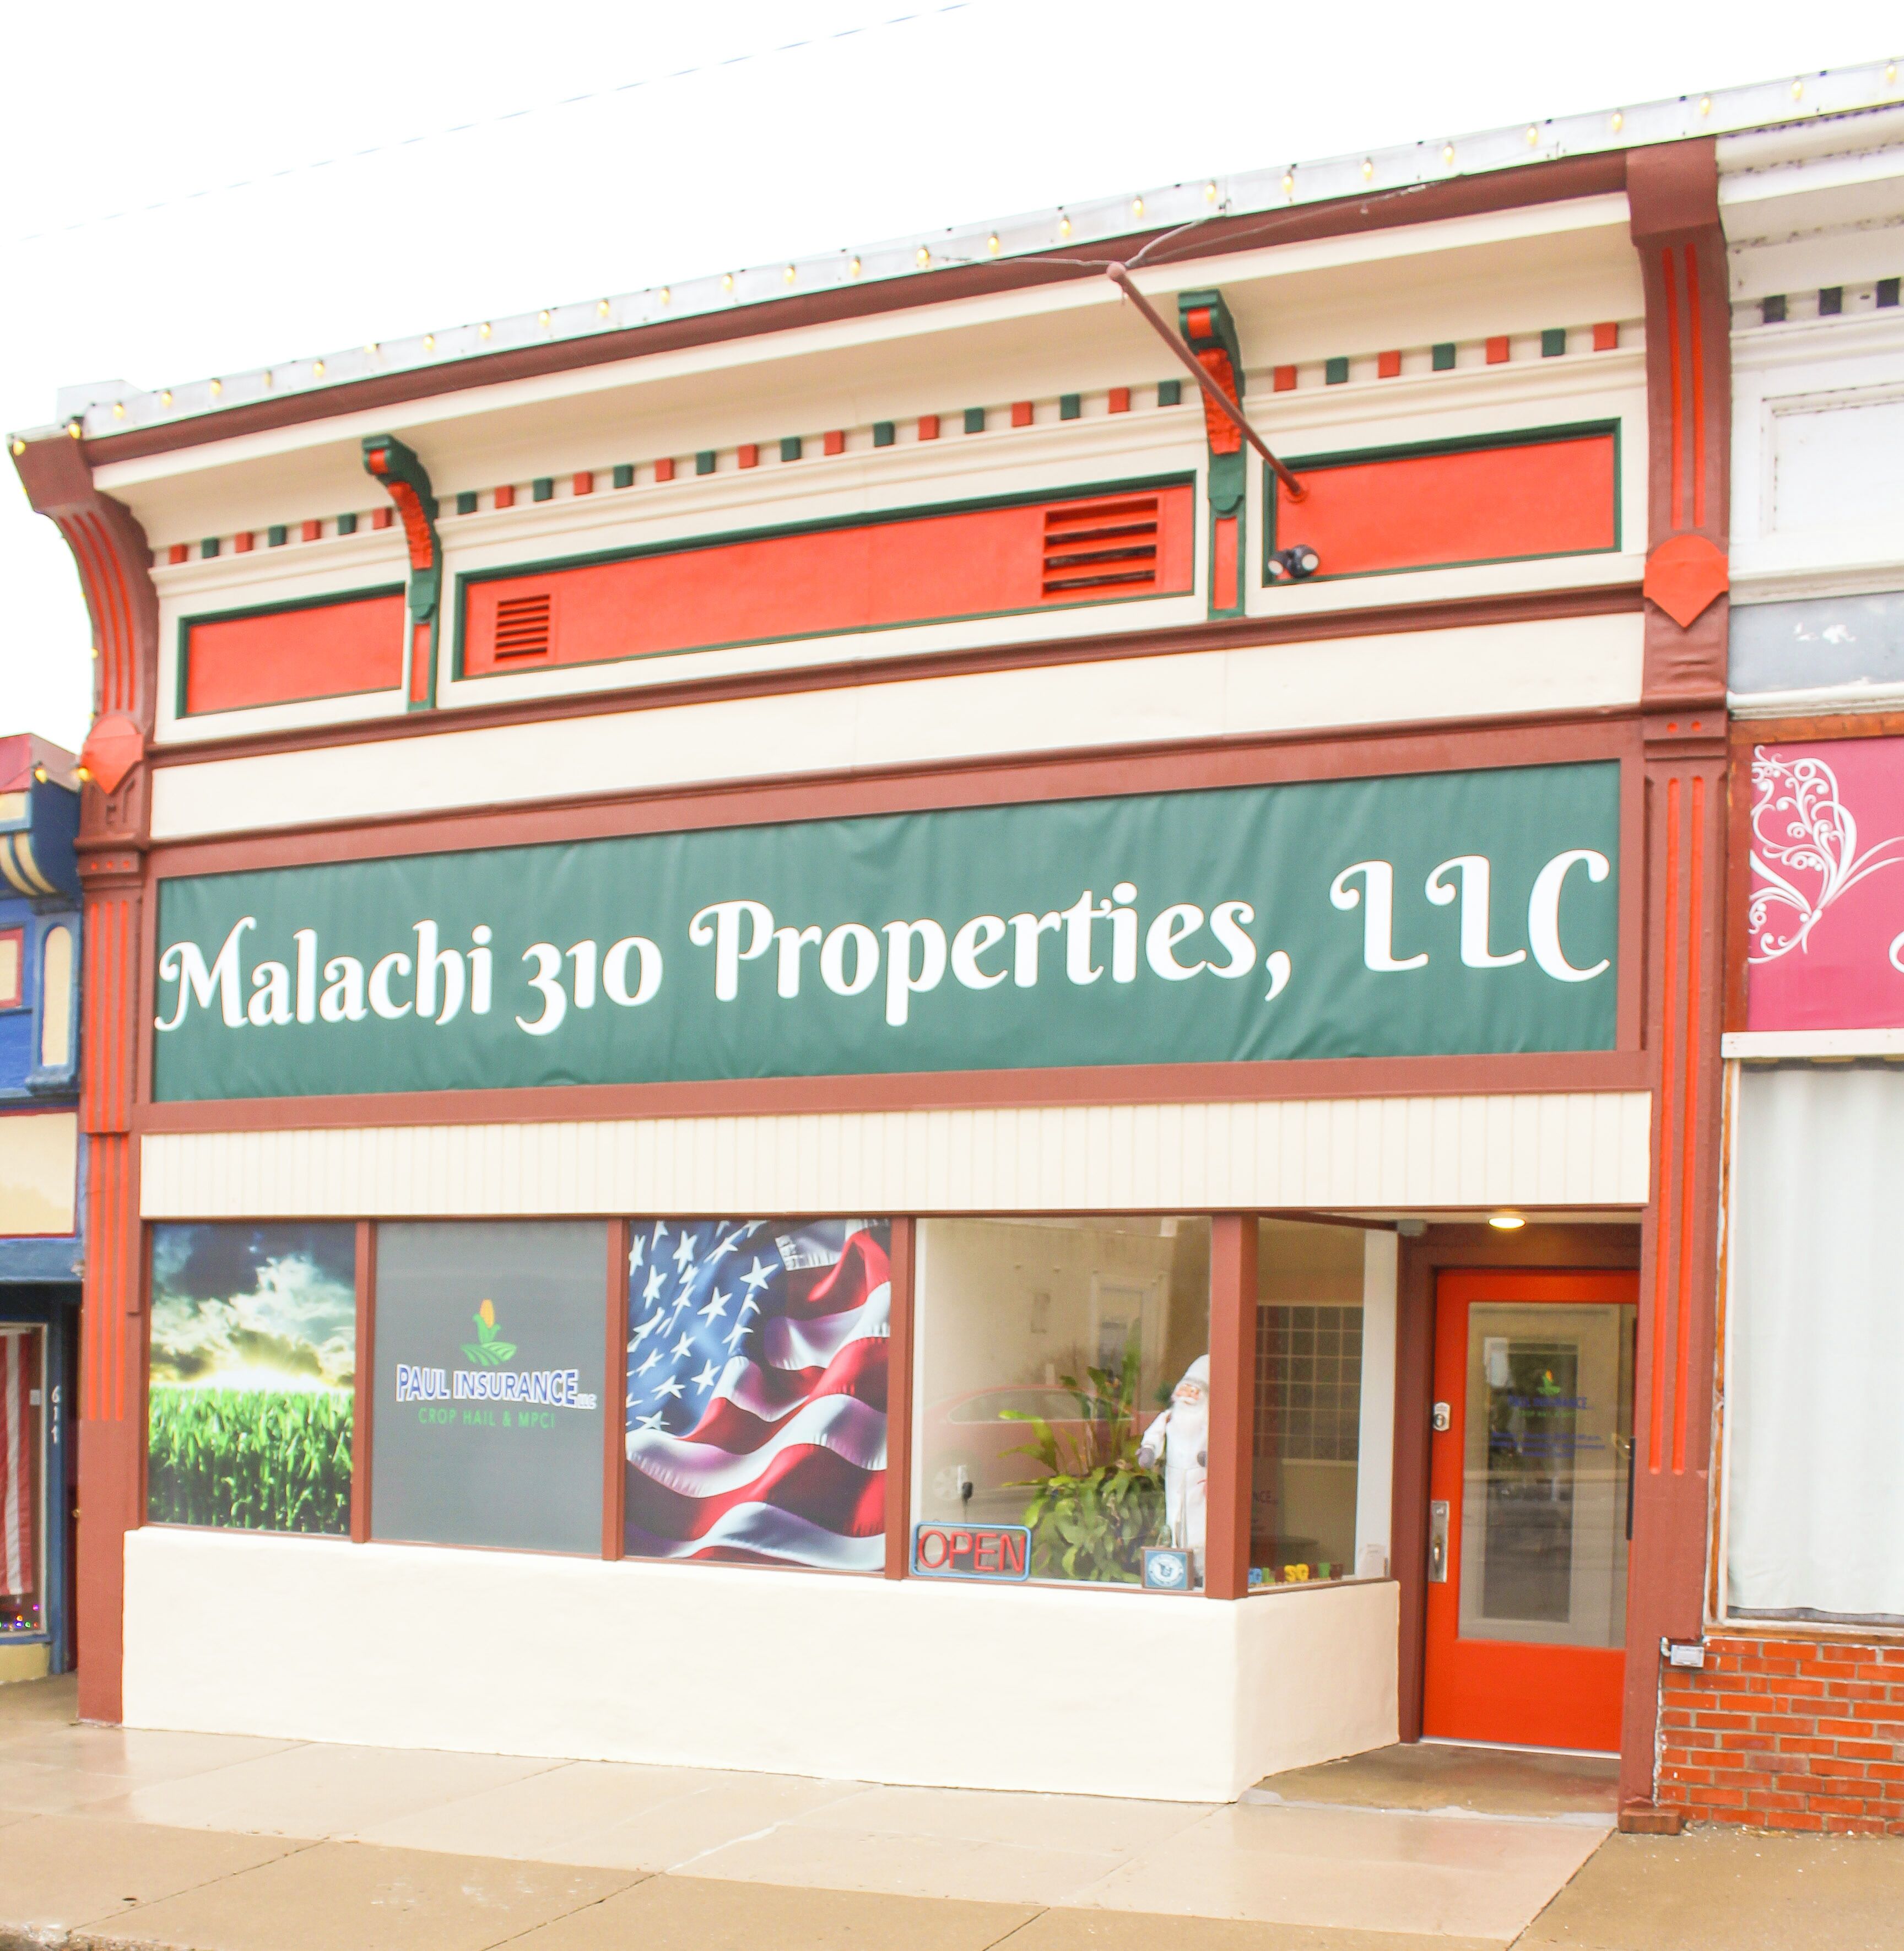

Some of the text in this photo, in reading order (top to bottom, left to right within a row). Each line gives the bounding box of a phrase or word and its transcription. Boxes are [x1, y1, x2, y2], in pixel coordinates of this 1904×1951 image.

[154, 849, 1610, 1036] Malachi 310 Properties, LLC
[396, 1364, 451, 1402] PAUL
[453, 1369, 578, 1408] INSURANCE
[418, 1407, 457, 1425] CROP
[462, 1409, 496, 1426] HAIL
[518, 1411, 556, 1429] MPCI
[917, 1530, 1026, 1572] OPEN
